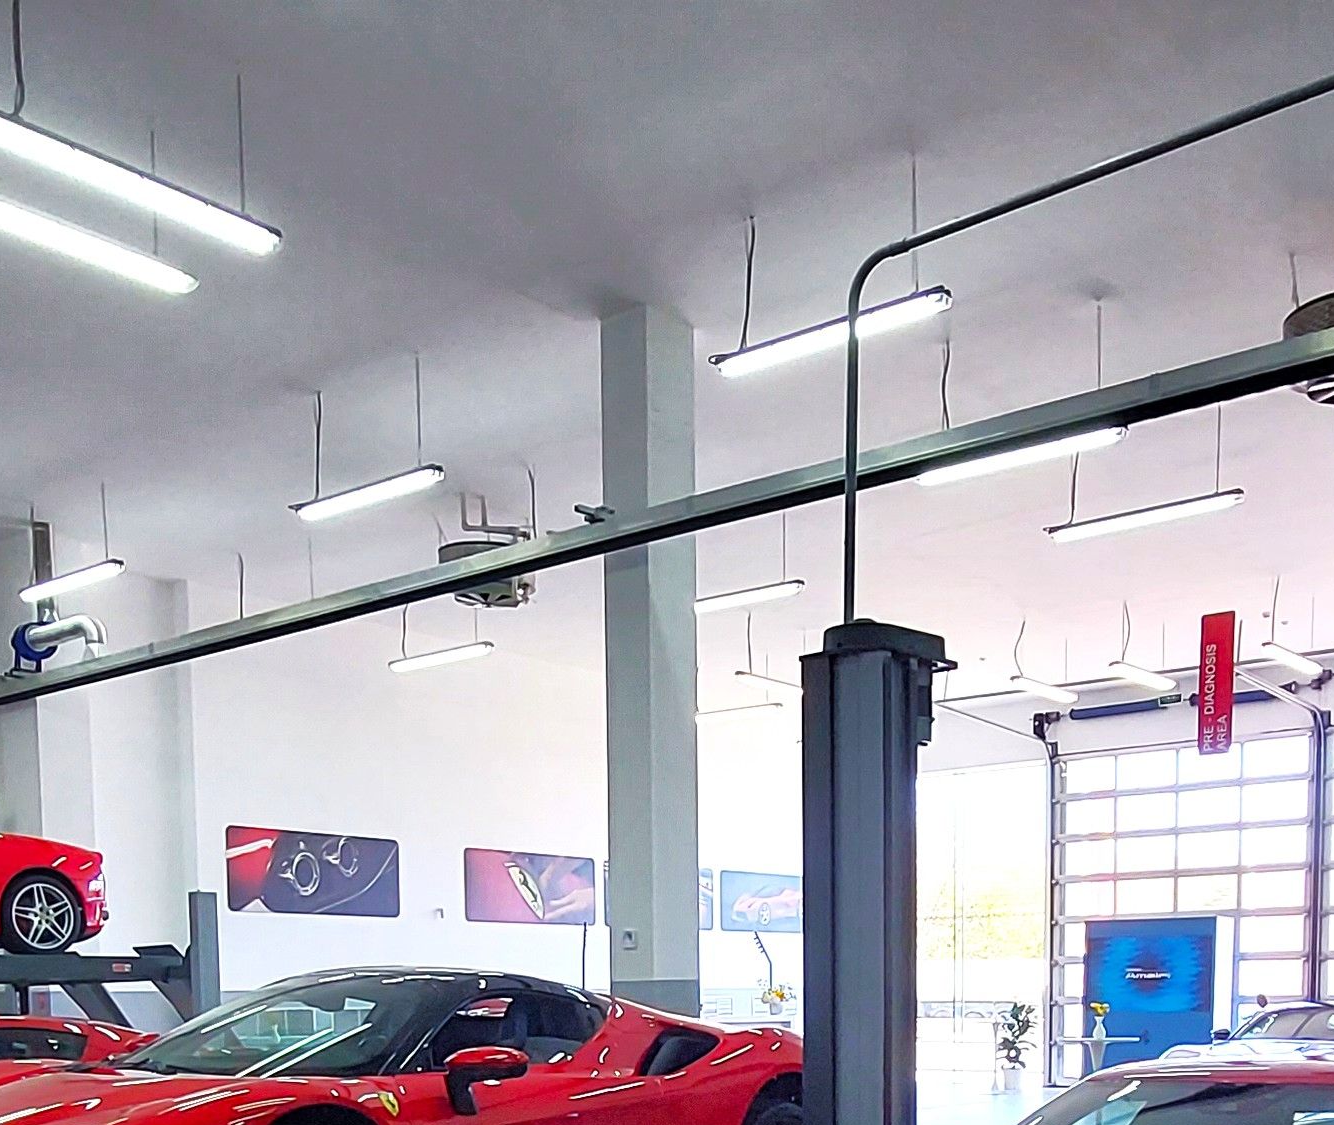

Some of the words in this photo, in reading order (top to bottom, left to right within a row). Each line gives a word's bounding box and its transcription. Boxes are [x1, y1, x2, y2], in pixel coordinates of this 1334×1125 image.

[1203, 643, 1217, 715] DIAGNOSIS
[1203, 725, 1215, 752] PRE
[1217, 714, 1229, 750] AREA
